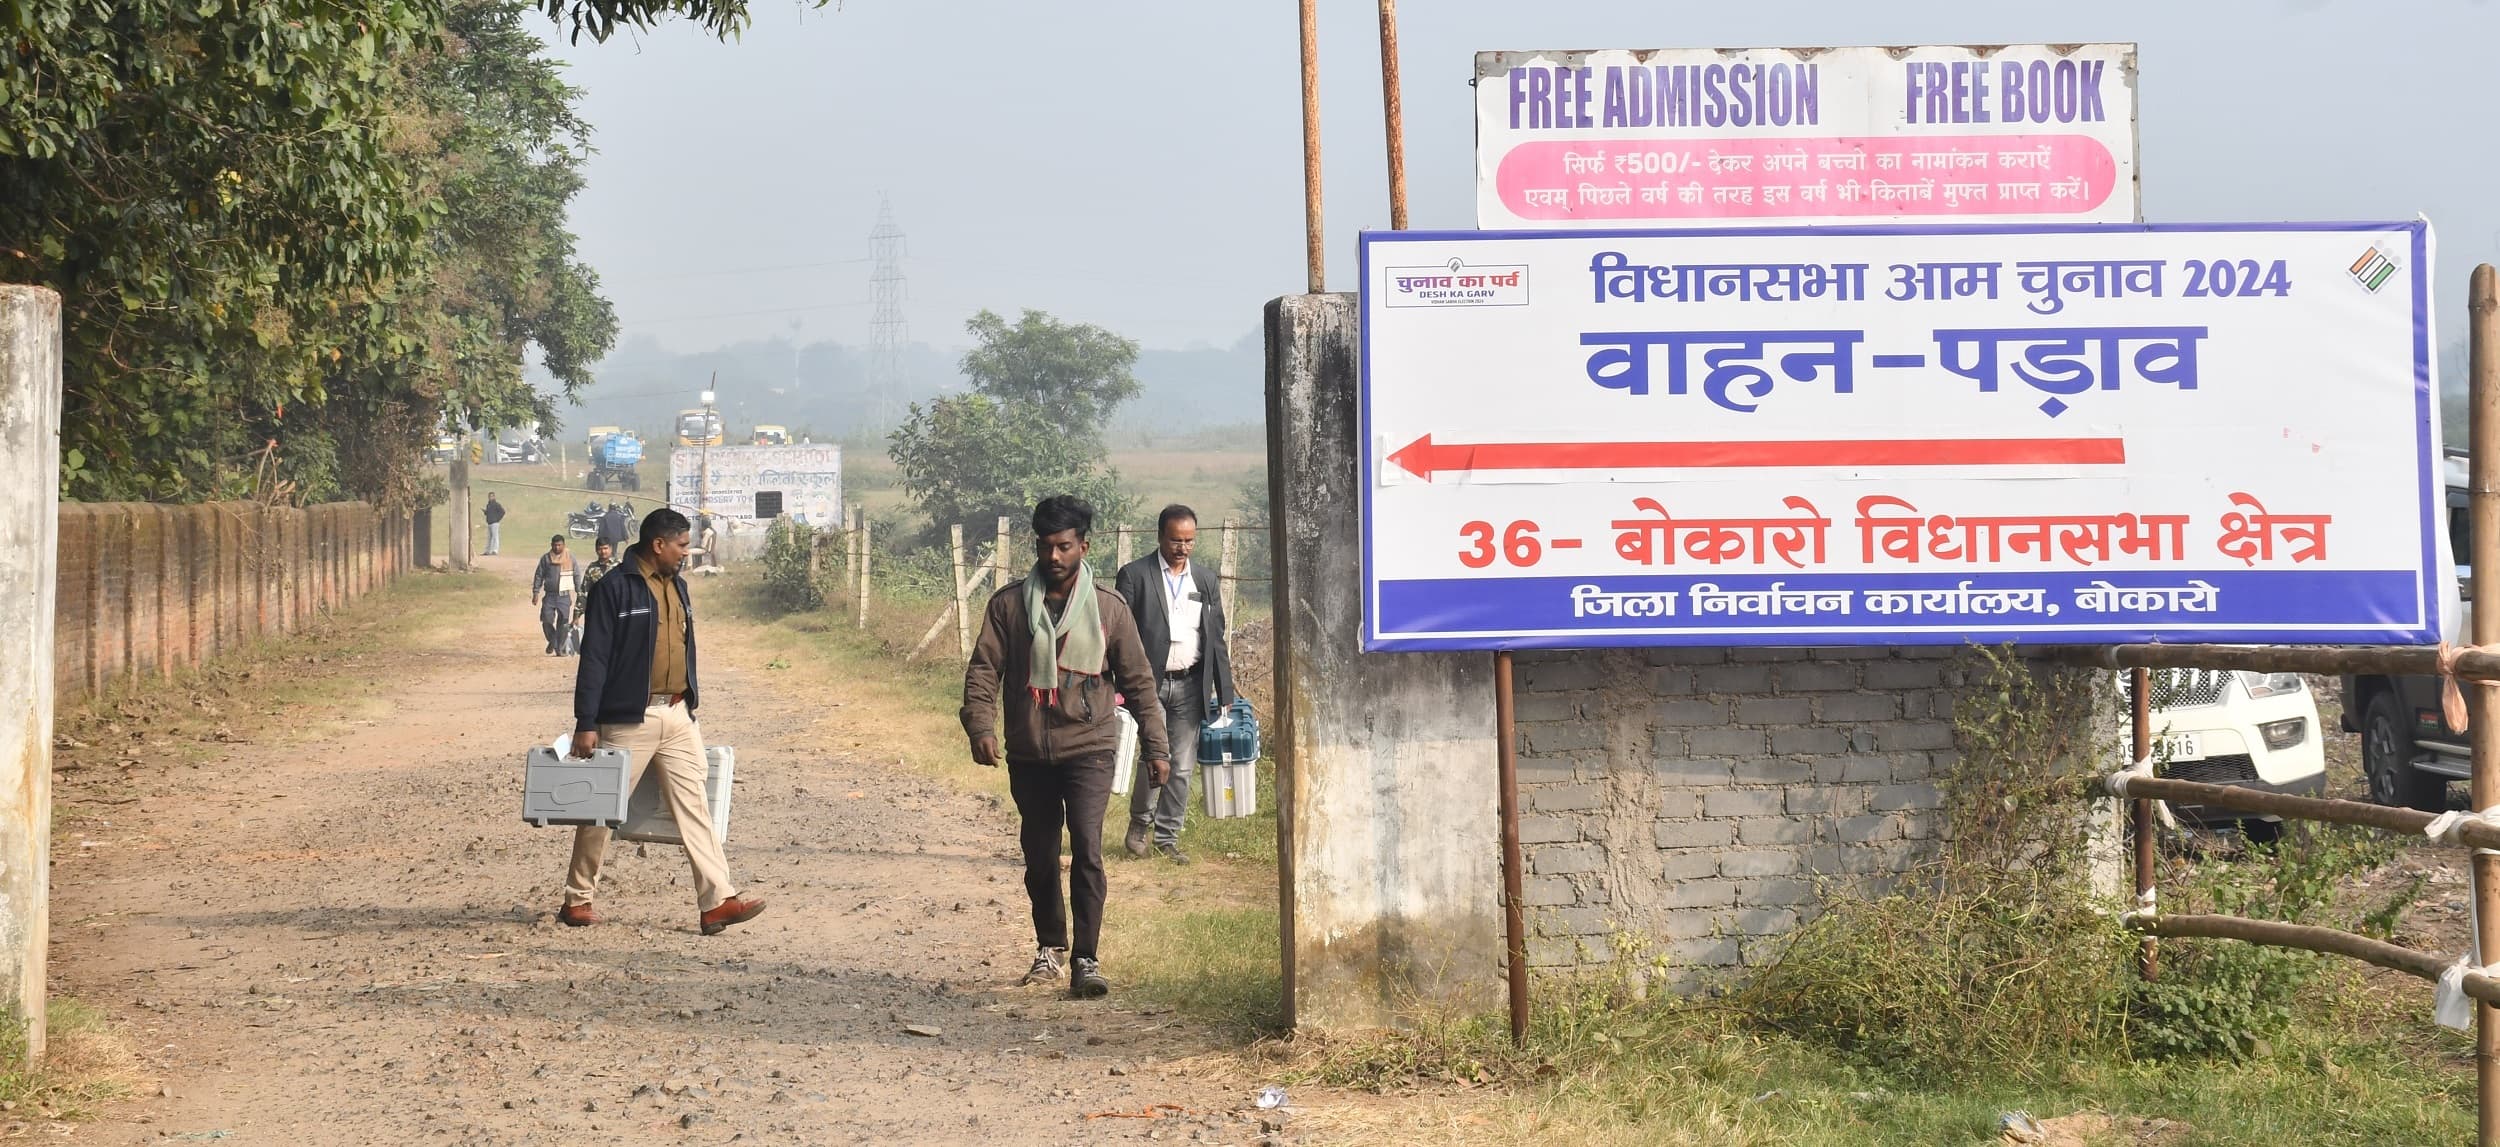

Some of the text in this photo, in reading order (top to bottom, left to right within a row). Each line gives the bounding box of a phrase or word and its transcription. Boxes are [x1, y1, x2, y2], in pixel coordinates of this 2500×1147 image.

[1509, 64, 1819, 128] FREE ADMISSION
[1907, 60, 2105, 123] FREE BOOK
[1563, 150, 1606, 174] सिर्फ
[1615, 151, 1701, 174] ₹500/-
[1708, 148, 1754, 175] देकर
[1763, 147, 1809, 172] अपने
[1875, 153, 1903, 170] का
[1911, 147, 1989, 170] नामांकन
[1577, 181, 1632, 205] पिछले
[1640, 180, 1669, 204] वर्ष
[1677, 181, 1705, 204] की
[1712, 186, 1754, 206] तरह
[1762, 185, 1792, 206] इस
[1799, 178, 1828, 202] वर्ष
[1836, 179, 1861, 201] भी
[1869, 177, 1935, 201] किताबें
[1997, 182, 2041, 201] प्राप्त
[1395, 271, 1520, 293] चुनाव का पर्व
[1419, 289, 1495, 299] DESH KA GARV
[1590, 252, 2293, 316] विधानसभा आम चुनाव 2024
[1457, 491, 2332, 569] 36- बोकारो विधानसभा क्षेत्र
[1569, 579, 2221, 618] जिला निर्वाचन कार्यालय, बोकारो
